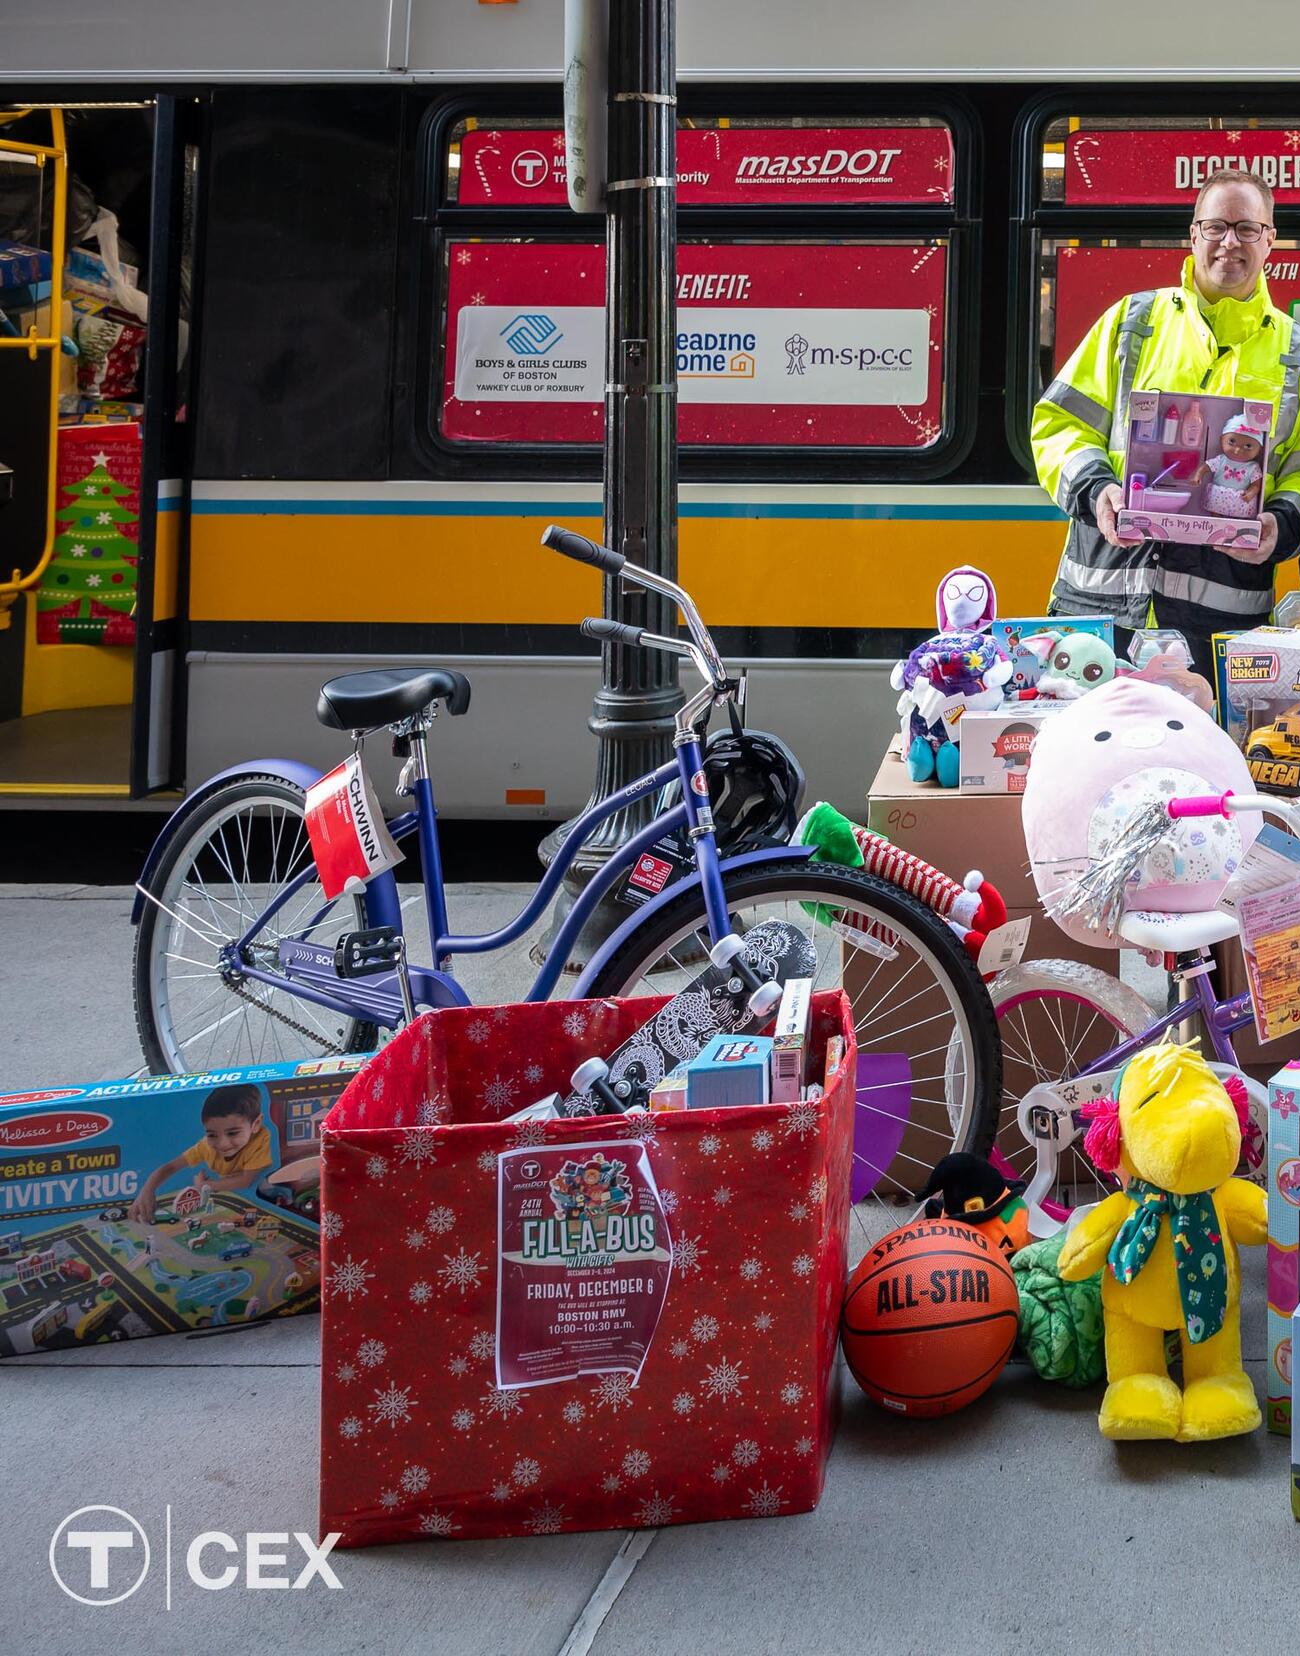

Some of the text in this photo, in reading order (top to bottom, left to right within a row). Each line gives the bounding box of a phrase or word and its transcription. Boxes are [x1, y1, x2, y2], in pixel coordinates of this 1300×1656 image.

[736, 149, 902, 176] massDOT
[735, 176, 893, 185] Massachusetts Department of Transportation
[1265, 262, 1298, 280] 24TH
[475, 360, 587, 369] BOYS & GIRLS CLUBS
[676, 353, 725, 372] ome
[503, 372, 557, 380] OF BOSTON
[476, 384, 509, 392] YAWKEY
[510, 384, 532, 392] CLUB
[1177, 519, 1191, 533] My
[1231, 657, 1254, 668] NEW
[1231, 667, 1270, 679] BRIGHT
[1003, 743, 1031, 751] WORD
[888, 808, 917, 831] 90
[88, 1077, 191, 1097] ACTIVITY
[197, 1072, 242, 1086] RUG
[67, 1120, 99, 1136] Doug
[0, 1151, 116, 1178] reate a Town
[84, 1171, 138, 1198] RUG
[521, 1199, 541, 1208] 24TH
[519, 1208, 543, 1217] ANNUAL
[523, 1215, 656, 1258] FILL-A-BUS
[872, 1224, 988, 1265] SPALDING
[566, 1255, 615, 1268] WITH GIFTS
[527, 1278, 654, 1300] FRIDAY, DECEMBER 6
[876, 1269, 990, 1316] ALL-STAR
[558, 1308, 626, 1322] BOSTON RMV
[614, 1320, 635, 1329] a.m.
